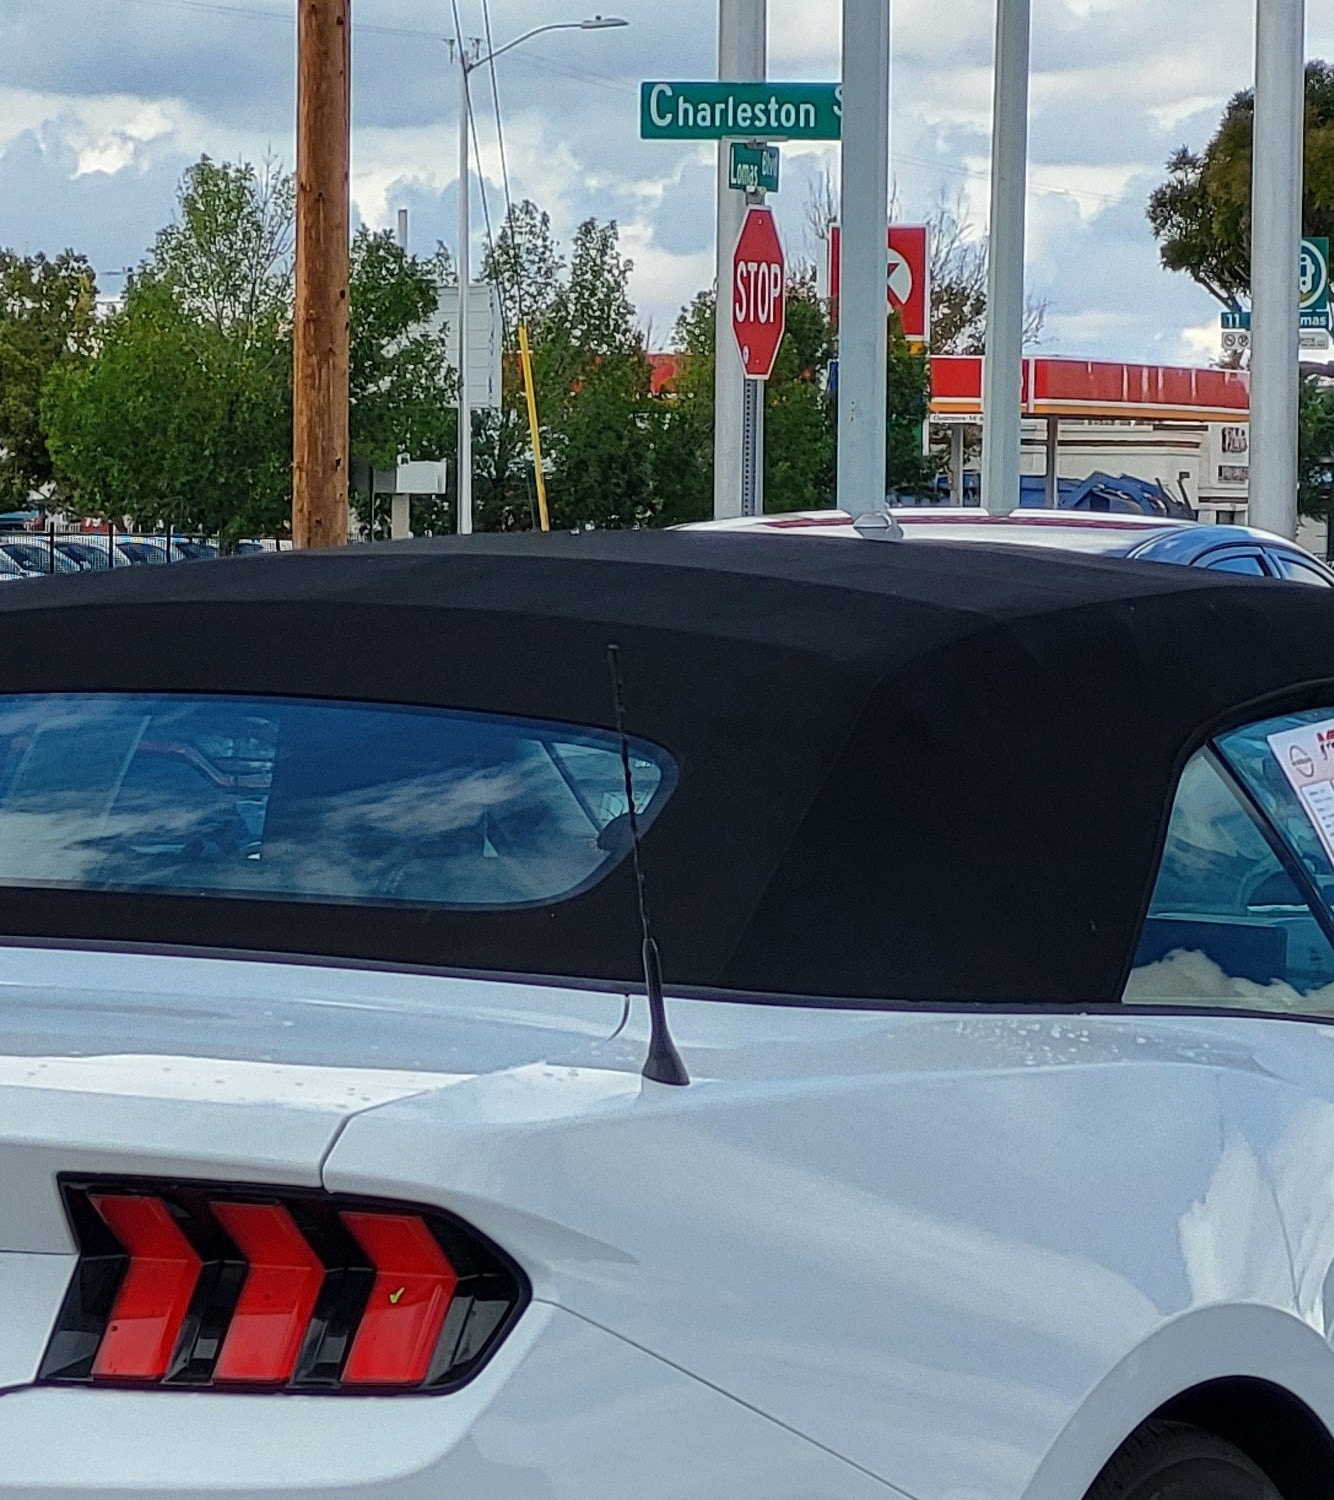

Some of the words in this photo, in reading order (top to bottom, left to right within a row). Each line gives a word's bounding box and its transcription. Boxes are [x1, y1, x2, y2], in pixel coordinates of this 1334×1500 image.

[650, 84, 816, 128] Charleston
[731, 147, 758, 186] Lomas
[735, 261, 781, 324] STOP
[1227, 314, 1242, 328] 11
